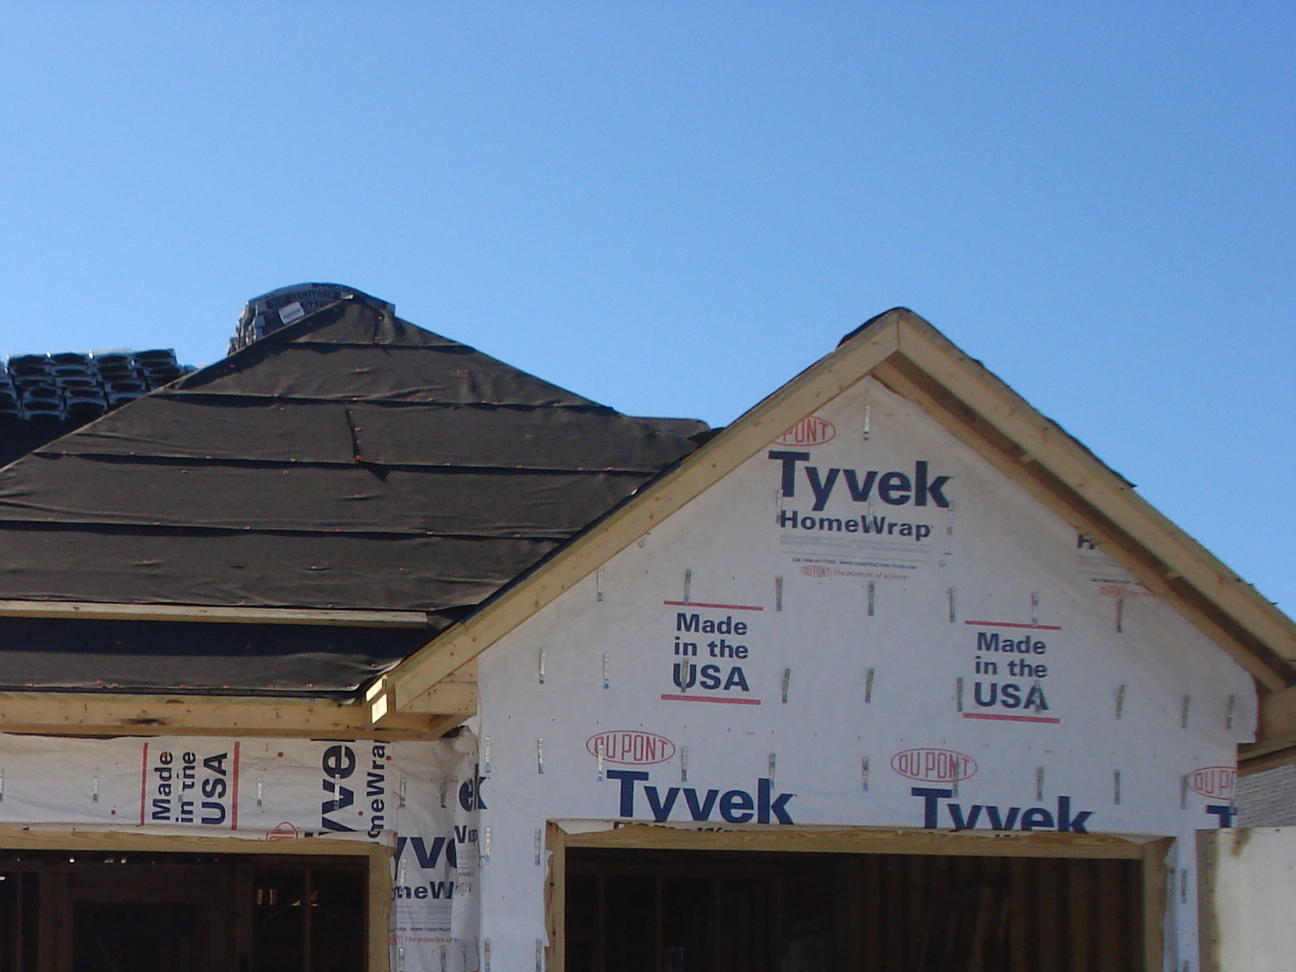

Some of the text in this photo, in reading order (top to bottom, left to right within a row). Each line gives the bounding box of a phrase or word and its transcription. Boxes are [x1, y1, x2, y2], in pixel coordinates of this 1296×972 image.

[768, 450, 952, 511] Tyvek
[780, 510, 931, 541] HomeWrap
[676, 612, 747, 635] Made
[674, 636, 748, 659] in the
[977, 632, 1046, 654] Made
[673, 663, 750, 692] USA
[975, 656, 1047, 678] in the
[974, 682, 1049, 710] USA
[152, 752, 173, 820] Made
[201, 752, 228, 825] USA
[607, 769, 795, 825] Tyvek
[176, 801, 194, 823] in
[911, 787, 1094, 833] Tyvek
